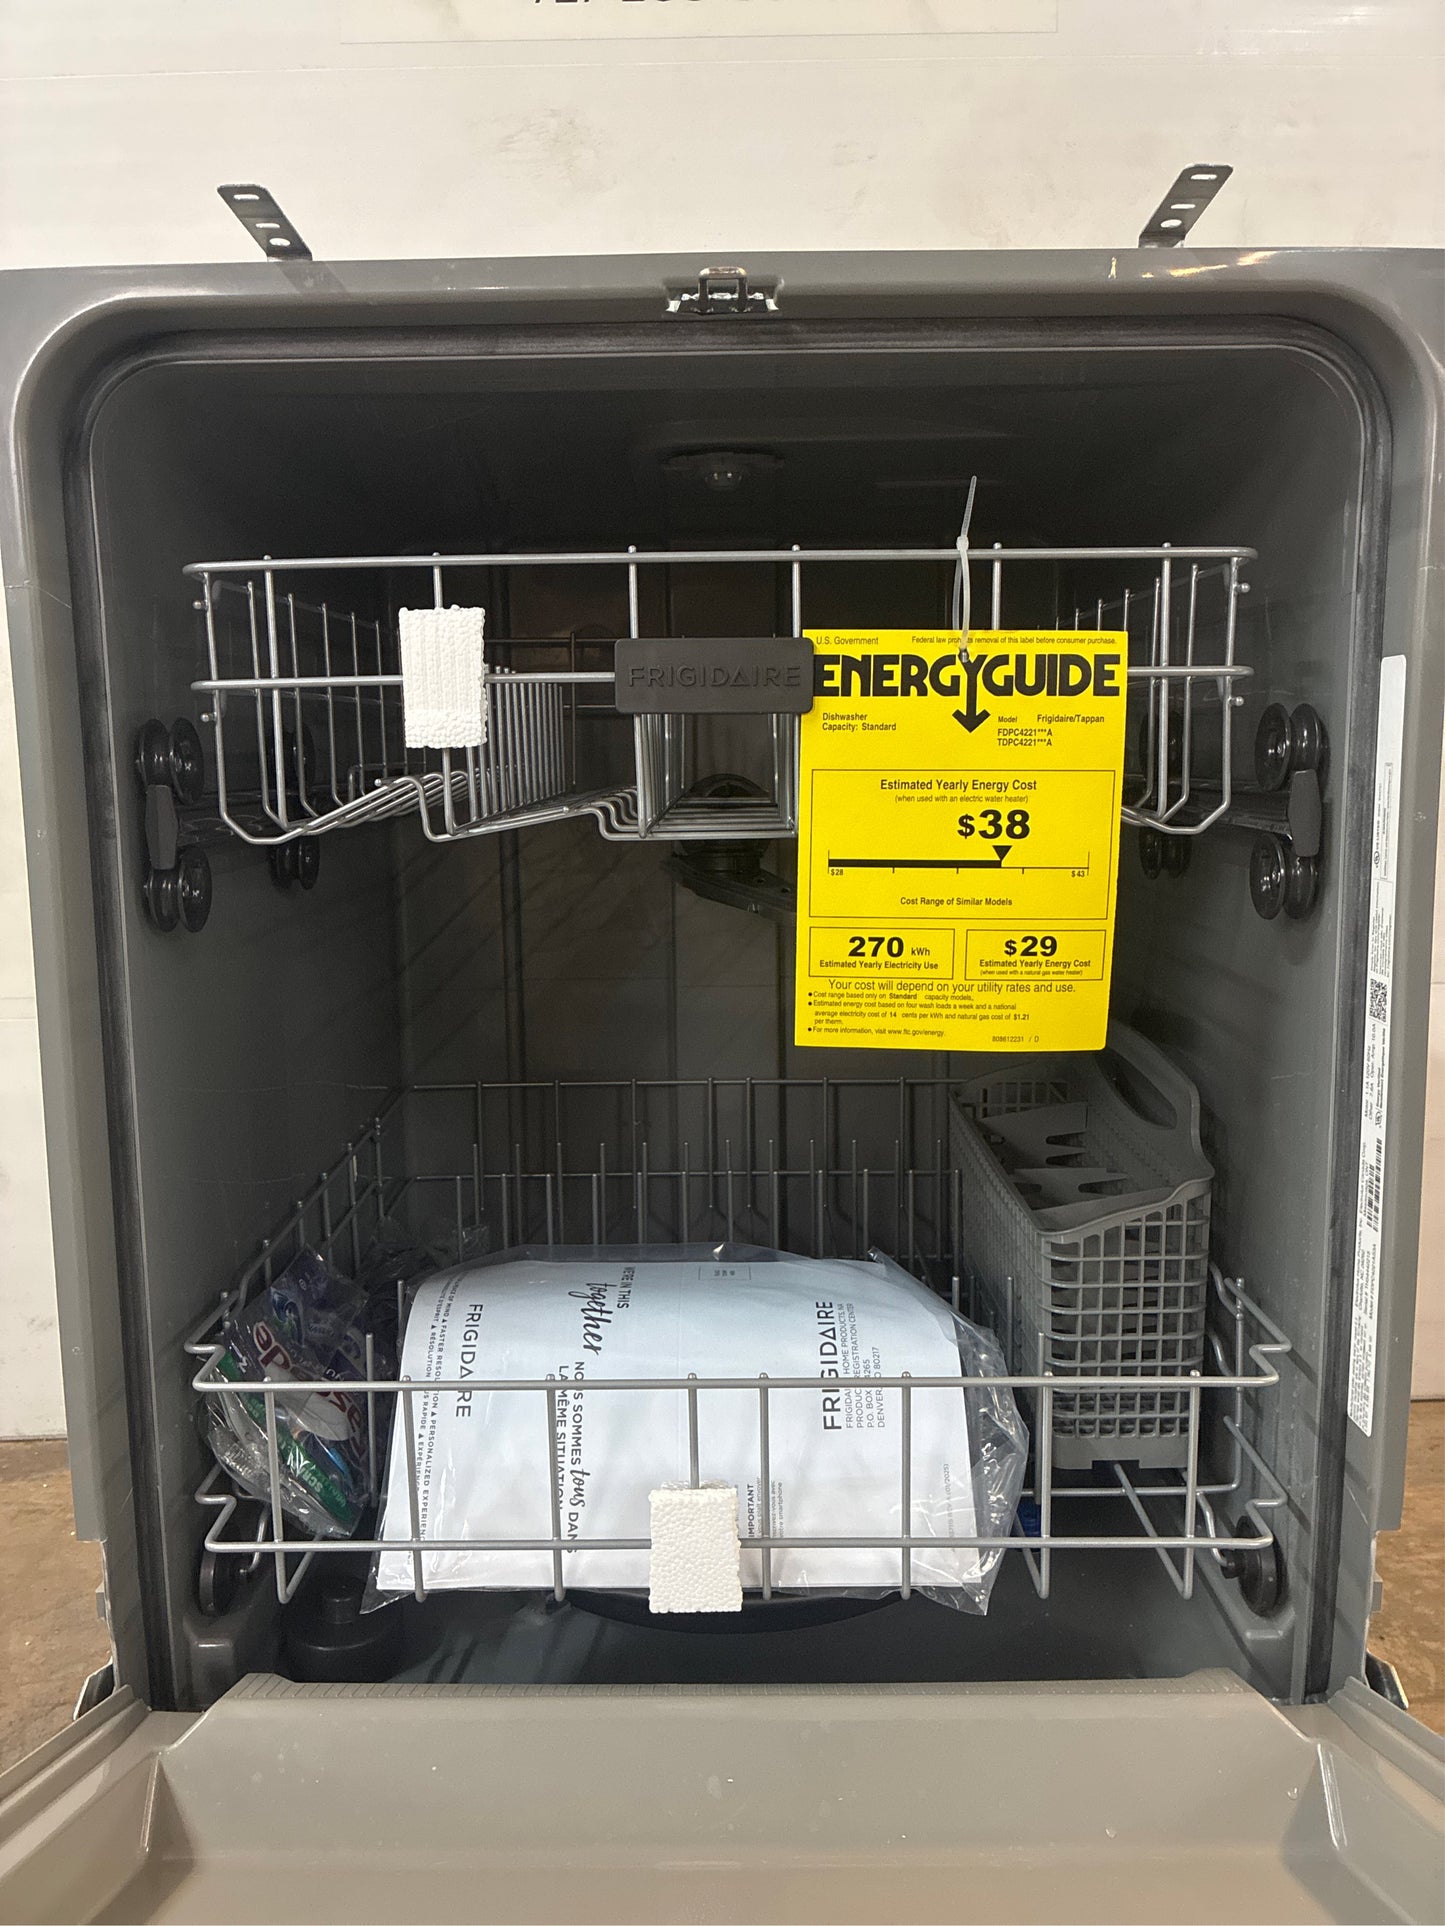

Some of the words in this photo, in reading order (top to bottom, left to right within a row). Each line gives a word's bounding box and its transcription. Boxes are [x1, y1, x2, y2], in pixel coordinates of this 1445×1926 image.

[816, 636, 832, 645] U.S.
[834, 636, 878, 645] Government
[1020, 636, 1034, 644] label
[1036, 636, 1055, 644] before
[628, 665, 801, 688] FRIGIDAIRE
[813, 654, 1120, 697] ENERGYGUIDE
[822, 722, 858, 732] Capacity:
[862, 722, 896, 731] Standard
[823, 712, 869, 723] Dishwasher
[1037, 714, 1104, 724] Frigidaire/Tappan
[881, 779, 932, 790] Estimated
[936, 779, 969, 792] Yearly
[972, 779, 1009, 792] Energy
[1012, 779, 1037, 790] Cost
[895, 794, 915, 803] (when
[917, 794, 933, 802] used
[934, 794, 948, 802] with
[985, 793, 1003, 802] water
[1005, 795, 1028, 804] heater)
[957, 809, 1030, 839] $38
[1071, 870, 1087, 878] $43
[900, 897, 918, 905] Cost
[920, 897, 944, 907] Range
[946, 897, 954, 905] of
[956, 897, 983, 906] Similar
[985, 898, 1012, 906] Models
[848, 936, 904, 958] 270
[1004, 936, 1057, 957] $29
[820, 960, 857, 968] Estimated
[859, 960, 882, 970] Yearly
[884, 960, 922, 971] Electricity
[924, 961, 938, 970] Use
[979, 959, 1017, 968] Estimated
[1019, 959, 1043, 970] Yearly
[1044, 959, 1072, 970] Energy
[1073, 959, 1091, 968] Cost
[814, 991, 827, 1000] Cost
[828, 992, 845, 1000] range
[889, 992, 917, 1002] Standard
[924, 994, 949, 1002] capacity
[828, 979, 852, 991] Your
[854, 981, 875, 991] cost
[877, 980, 893, 992] will
[896, 981, 934, 994] depend
[936, 984, 949, 992] on
[952, 984, 973, 994] your
[978, 981, 1002, 994] utility
[1006, 983, 1030, 992] rates
[1034, 982, 1052, 992] and
[1055, 984, 1076, 992] use.
[814, 1011, 838, 1019] average
[839, 1010, 866, 1018] electricity
[1013, 1013, 1029, 1021] $1.21
[617, 1290, 631, 1308] THIS
[568, 1282, 618, 1355] together
[847, 1303, 856, 1323] CENTER
[437, 1325, 446, 1352] FASTER
[425, 1332, 436, 1377] RÉSOLUTION
[456, 1304, 483, 1417] FRIGIDARE
[816, 1301, 842, 1430] FRIGIDAIRE
[842, 1350, 850, 1374] HOME
[872, 1347, 881, 1369] 80217
[432, 1355, 442, 1408] RESOLION
[573, 1362, 585, 1400] NOS
[844, 1388, 853, 1428] FRIGIDAI
[855, 1389, 864, 1428] PRODUC
[865, 1390, 874, 1409] BOX
[420, 1402, 428, 1430] RAPIDE
[571, 1404, 583, 1465] SOMMES
[423, 1420, 436, 1486] PERSONALIZED
[416, 1442, 424, 1492] EXPÉRIE
[570, 1468, 590, 1507] tous
[420, 1490, 429, 1541] EXPERIENC
[747, 1484, 755, 1538] IMPORTANT
